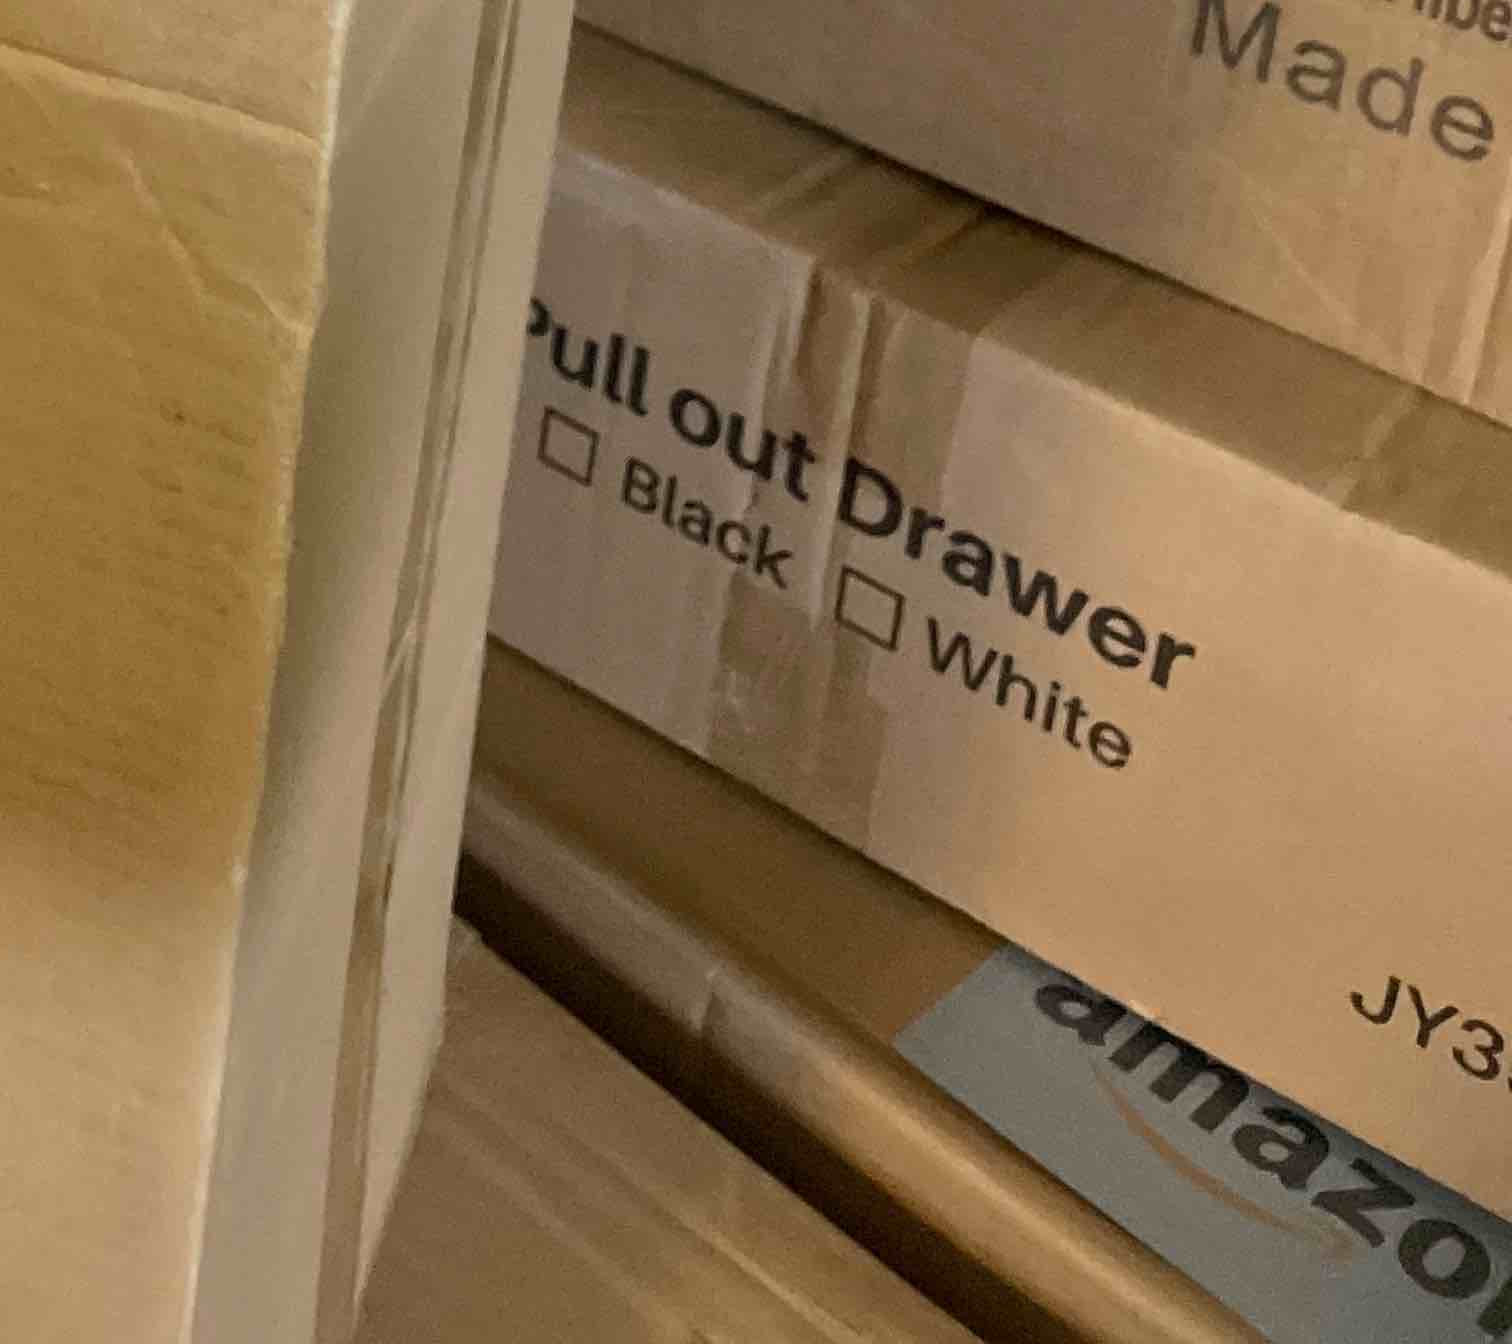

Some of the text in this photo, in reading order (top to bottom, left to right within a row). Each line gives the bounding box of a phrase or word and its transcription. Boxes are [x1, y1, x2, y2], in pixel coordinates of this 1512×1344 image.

[620, 455, 1133, 770] Black White
[668, 388, 816, 502] out
[838, 456, 1197, 690] Drawer
[1349, 975, 1512, 1095] JY3
